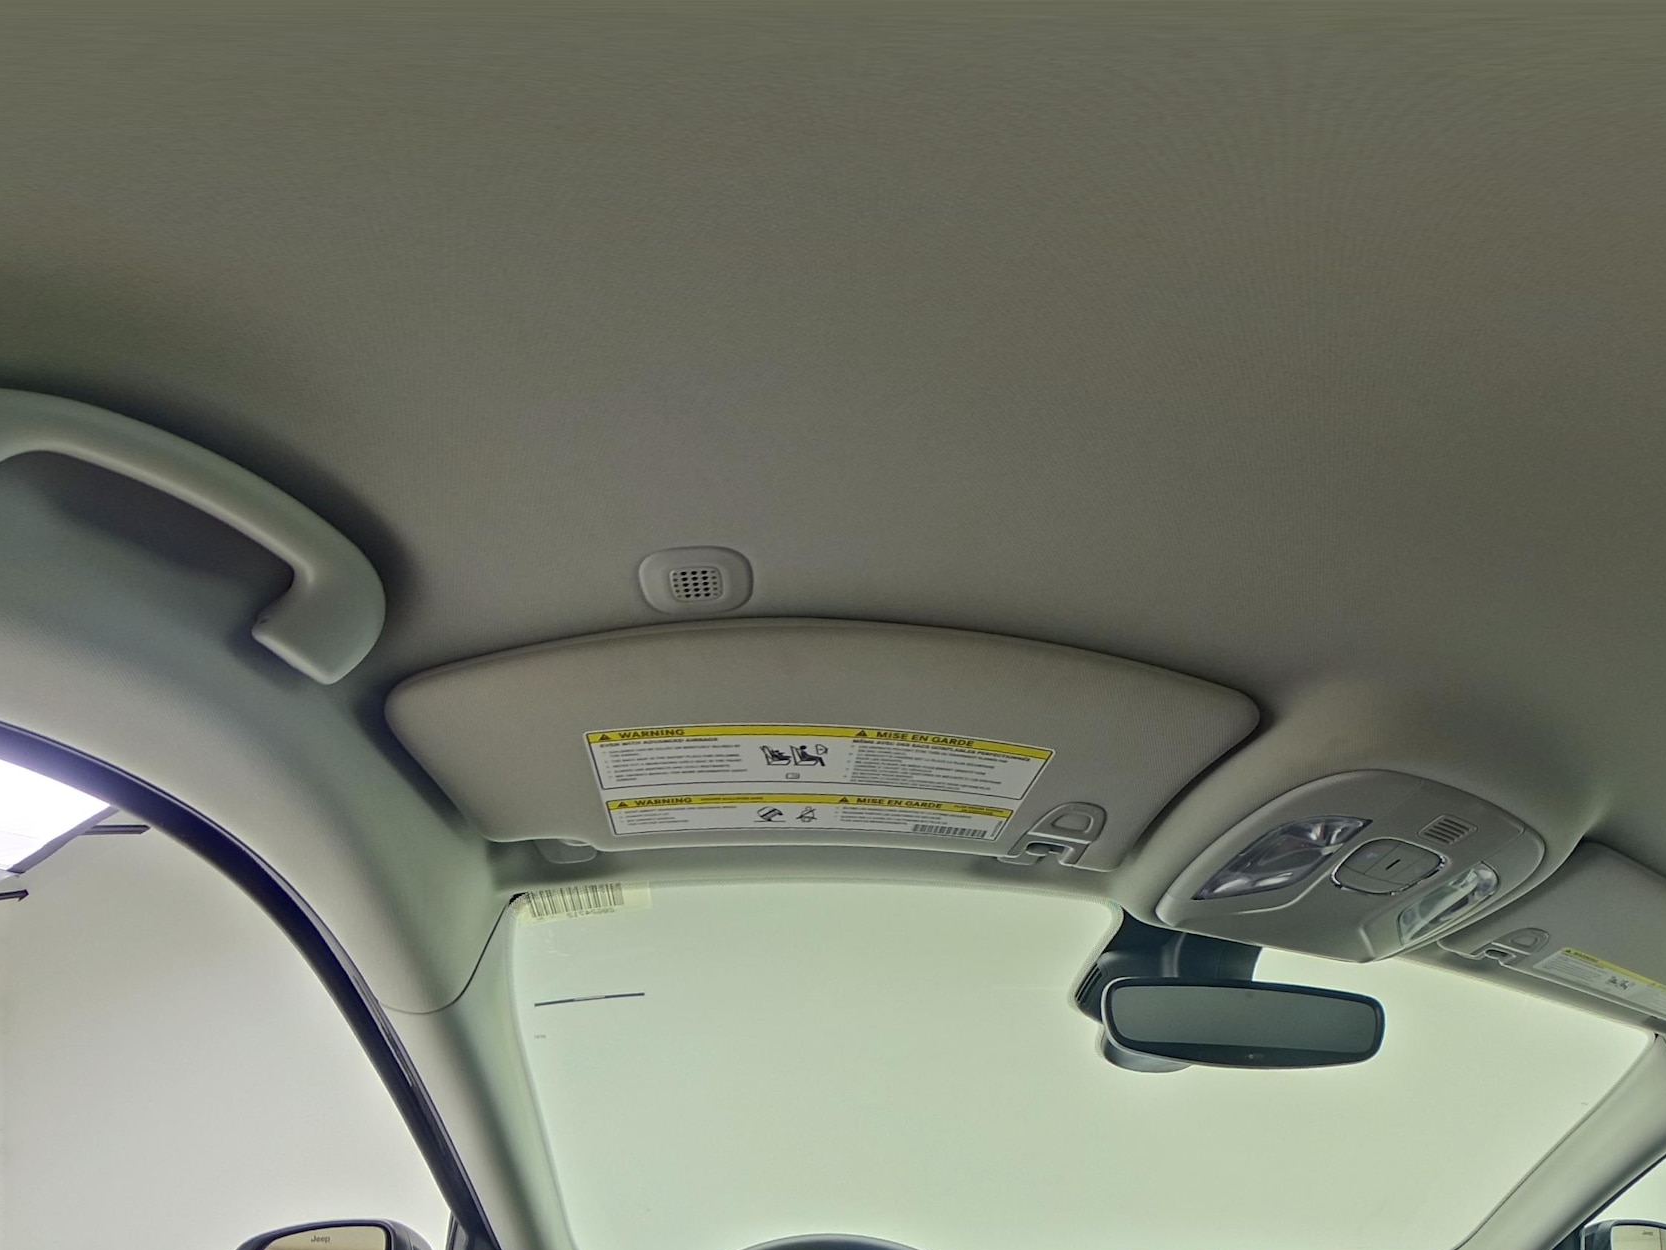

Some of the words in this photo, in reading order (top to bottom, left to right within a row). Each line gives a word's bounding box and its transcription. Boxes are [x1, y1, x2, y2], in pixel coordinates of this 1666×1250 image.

[619, 729, 685, 740] WARNING
[876, 731, 908, 740] MISE
[911, 734, 928, 742] EN
[932, 736, 974, 747] GARDE
[634, 797, 693, 806] WARNING
[856, 797, 885, 805] MISE
[905, 801, 943, 809] GARDE
[310, 1234, 331, 1244] Jeep
